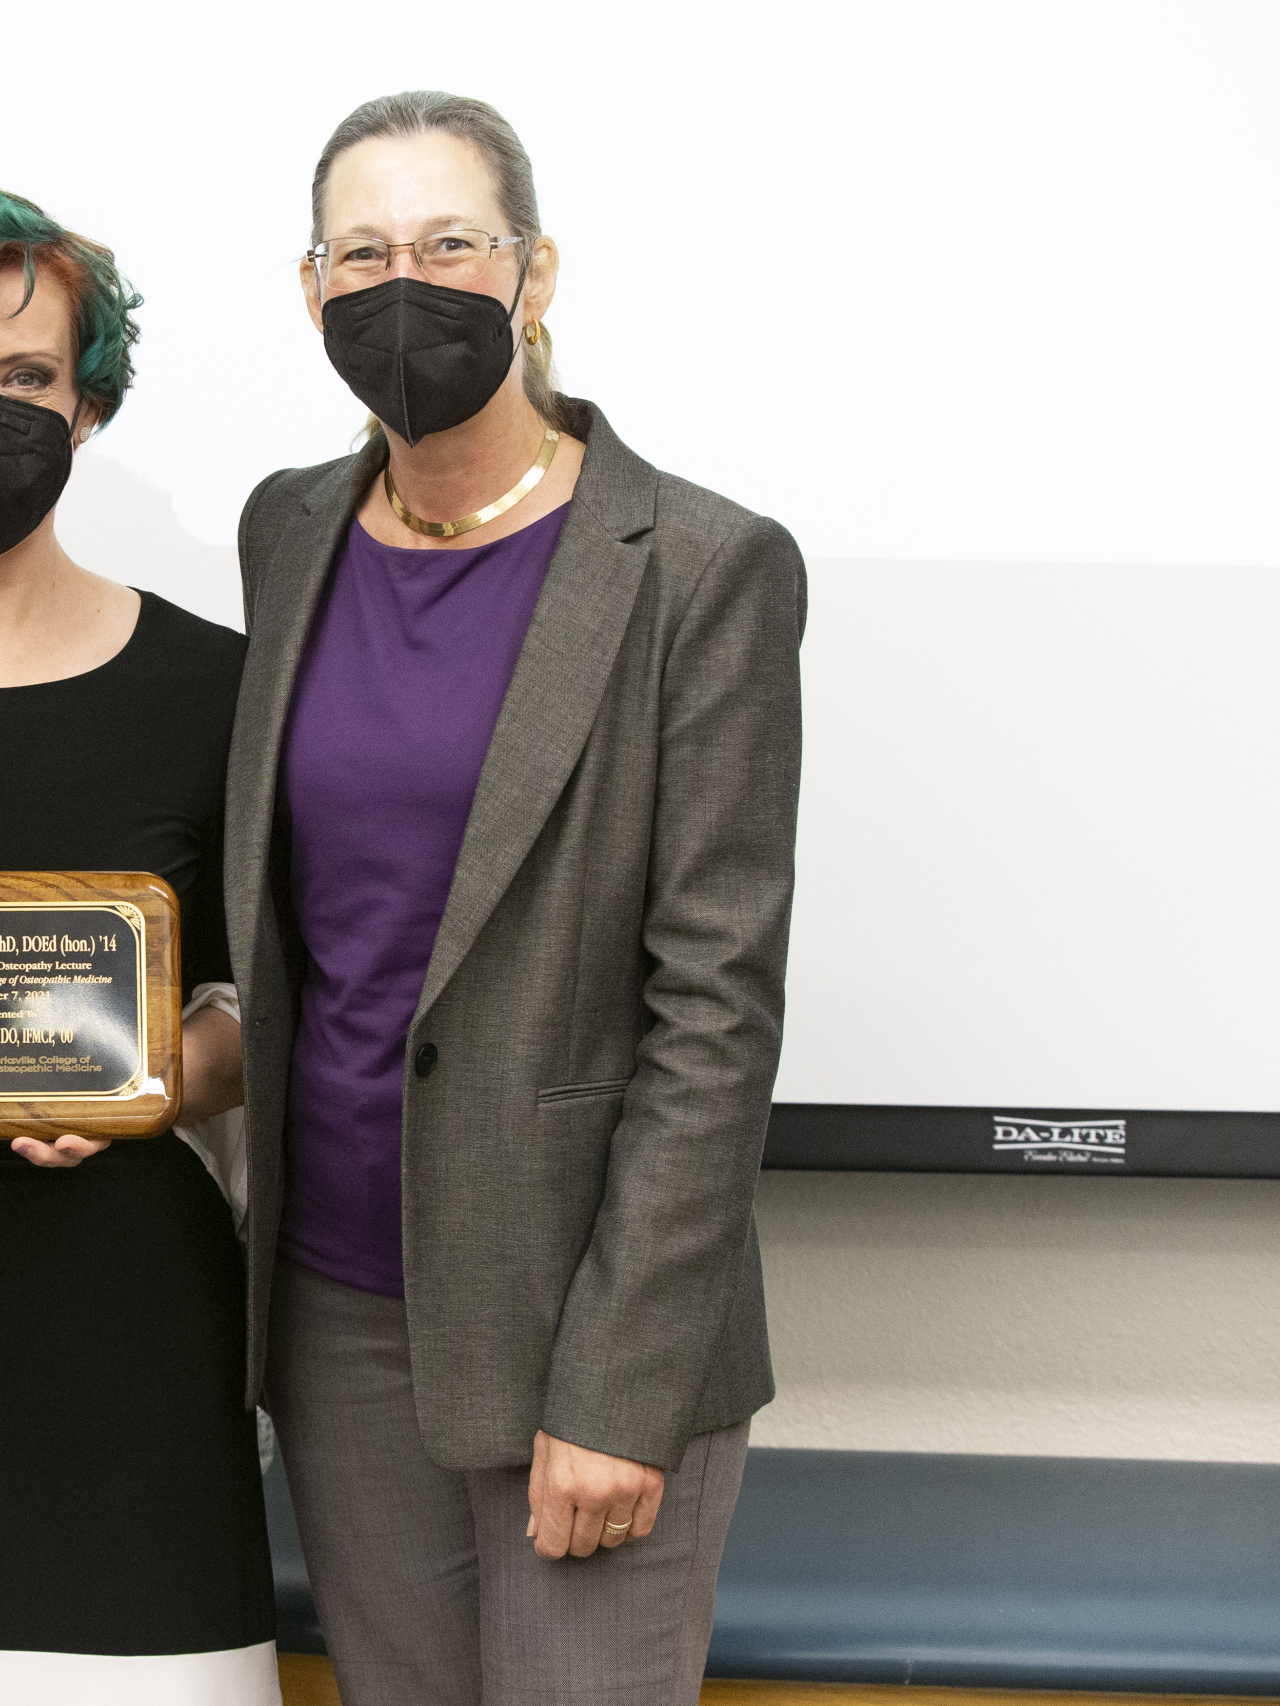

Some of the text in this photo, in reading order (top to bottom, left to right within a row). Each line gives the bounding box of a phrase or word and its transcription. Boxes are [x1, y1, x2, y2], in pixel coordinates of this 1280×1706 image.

[22, 935, 57, 952] DOEd
[60, 935, 96, 957] (hon.)
[55, 961, 92, 970] Lecture
[8, 975, 19, 986] of
[19, 975, 72, 986] Osteopathic
[72, 974, 113, 984] Medicine
[11, 991, 22, 1001] 7,
[24, 990, 51, 1001] 2021
[0, 1027, 20, 1047] DO,
[39, 1056, 77, 1065] College
[80, 1055, 91, 1064] of
[56, 1064, 103, 1072] Medicine
[993, 1125, 1126, 1144] DA-LITE
